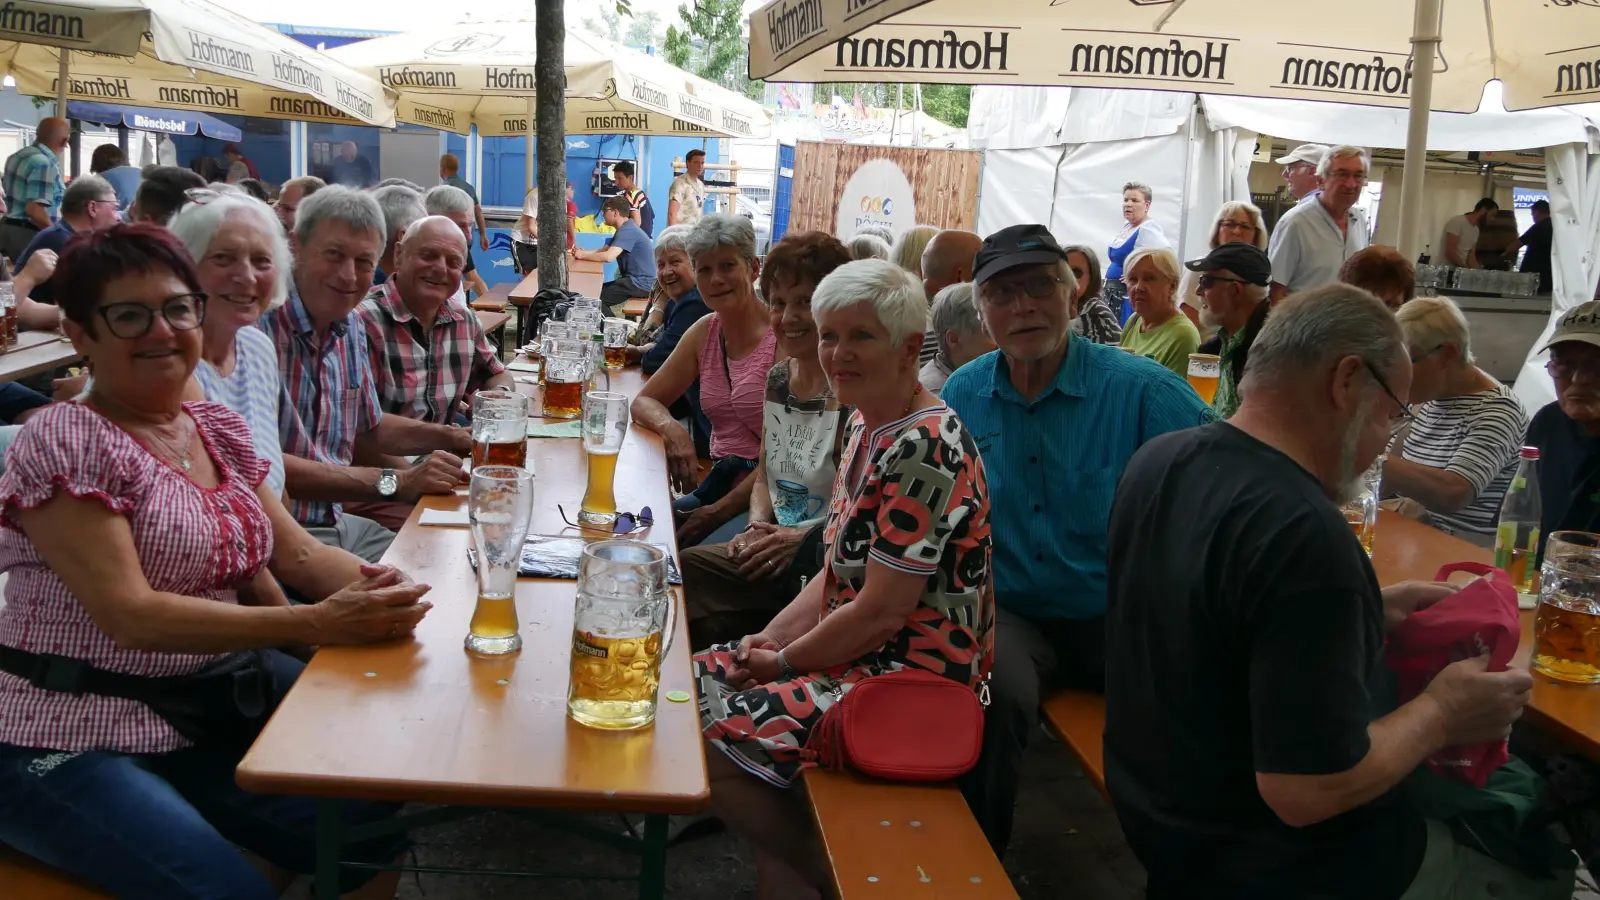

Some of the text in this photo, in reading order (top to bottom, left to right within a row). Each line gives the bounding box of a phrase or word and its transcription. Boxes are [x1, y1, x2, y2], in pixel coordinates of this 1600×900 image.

[0, 2, 84, 39] fmann
[767, 0, 824, 54] Hofmann
[188, 31, 255, 73] Hofmann
[272, 54, 323, 93] Hofmann
[380, 67, 456, 87] Hofmann
[486, 67, 568, 89] Hofm
[335, 80, 373, 119] Hofmann
[631, 78, 669, 108] Hofmann
[679, 94, 712, 123] Hofmann
[722, 110, 752, 135] Hofmann
